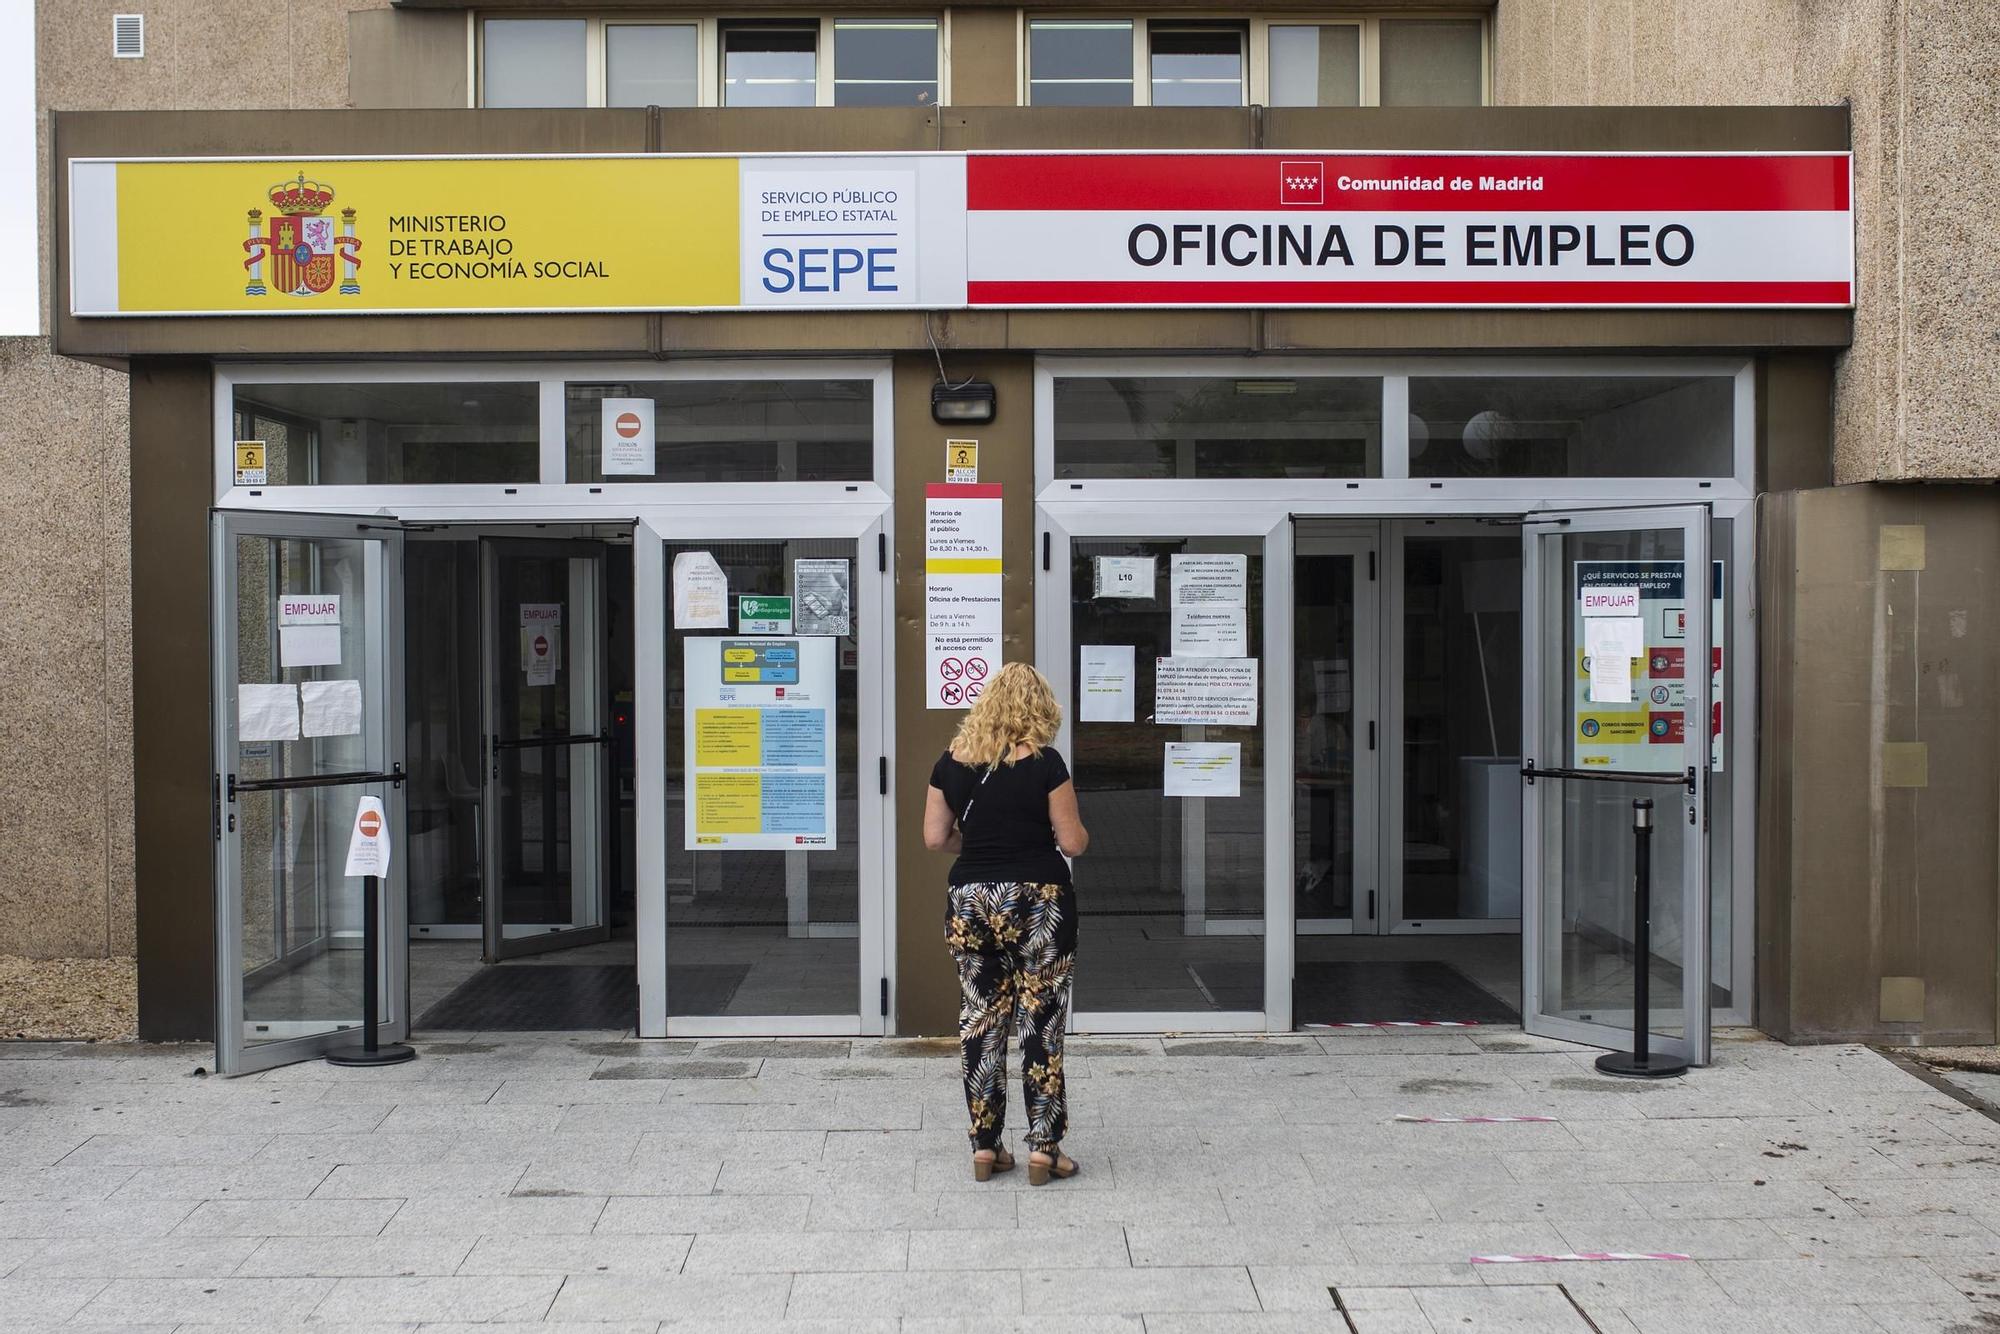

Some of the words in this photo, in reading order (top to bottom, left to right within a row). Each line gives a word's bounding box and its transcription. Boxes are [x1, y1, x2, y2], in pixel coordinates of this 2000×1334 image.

[1337, 175, 1444, 191] Comunidad
[1450, 175, 1473, 191] de
[1479, 175, 1543, 191] Madrid
[761, 191, 828, 204] SERVICIO
[833, 188, 897, 204] PÚBLICO
[389, 215, 506, 232] MINISTERIO
[761, 210, 779, 222] DE
[784, 210, 838, 222] EMPLEO
[842, 209, 898, 222] ESTATAL
[390, 239, 416, 256] DE
[420, 238, 513, 260] TRABAJO
[1127, 223, 1354, 267] OFICINA
[1374, 224, 1446, 266] DE
[1466, 223, 1695, 266] EMPLEO
[389, 263, 402, 279] Y
[409, 258, 527, 279] ECONOMÍA
[533, 262, 609, 278] SOCIAL
[762, 248, 898, 293] SEPE
[1118, 573, 1133, 581] L10
[1583, 571, 1601, 581] ¿QUÉ
[1602, 572, 1639, 580] SERVICIOS
[285, 603, 335, 615] EMPUJAR
[1585, 596, 1635, 607] EMPUJAR
[523, 609, 558, 619] EMPUJAR
